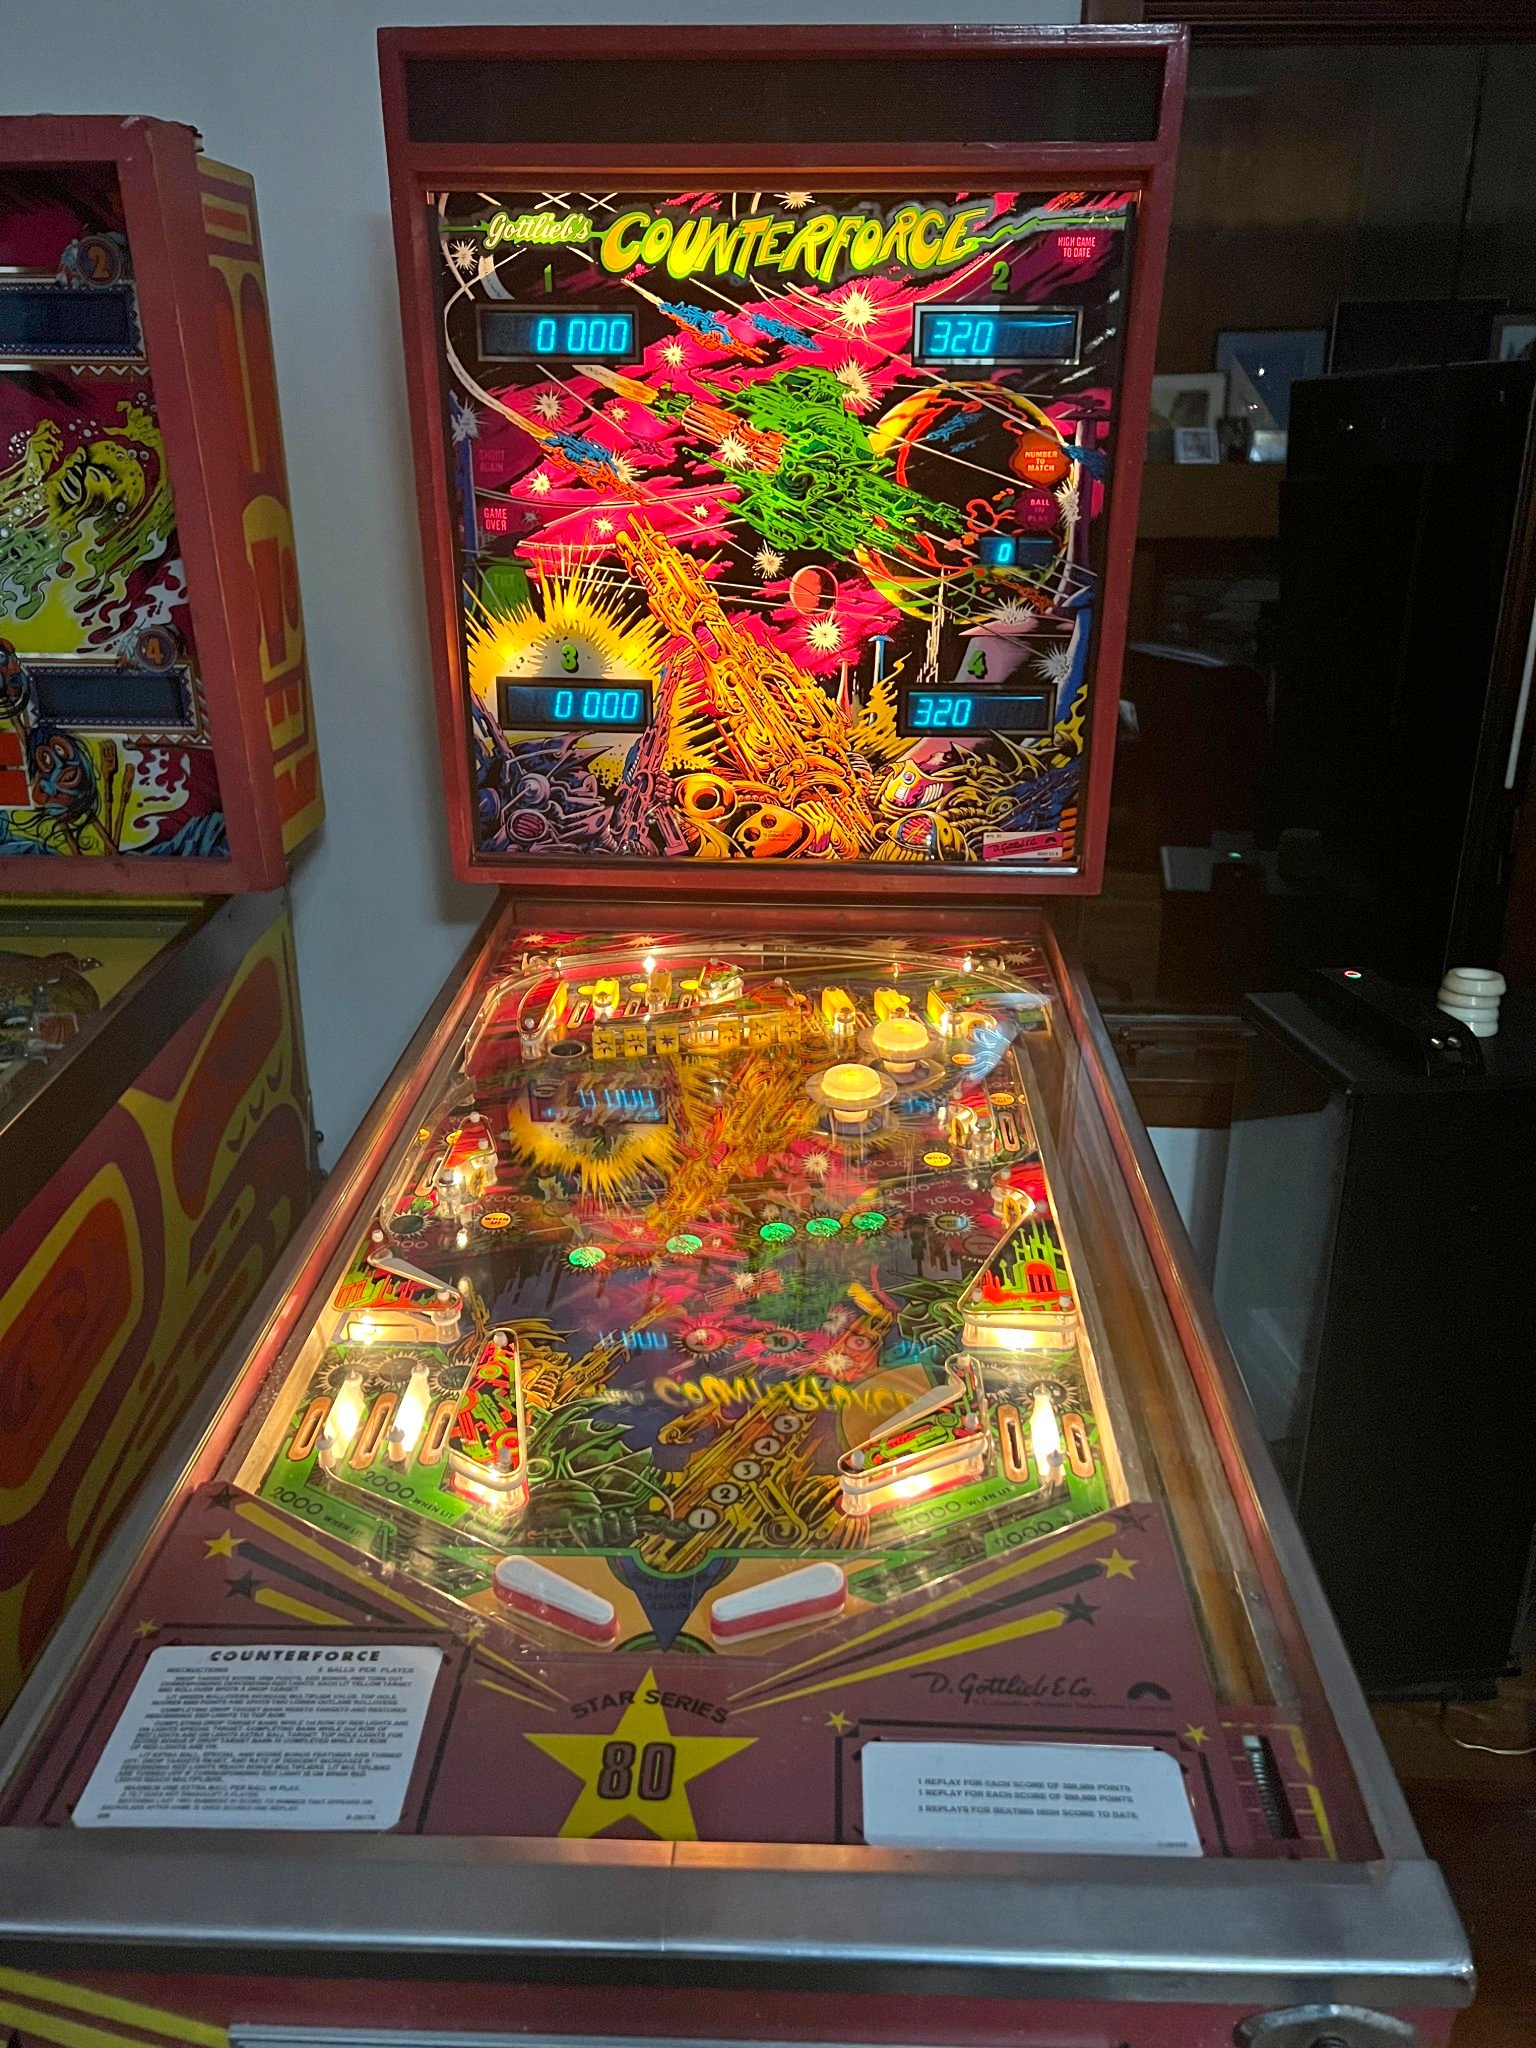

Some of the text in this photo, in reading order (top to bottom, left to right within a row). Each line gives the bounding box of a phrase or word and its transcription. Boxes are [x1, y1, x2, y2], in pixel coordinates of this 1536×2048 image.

[485, 207, 990, 283] Gottlieb's COUNTERFORCE
[1057, 236, 1096, 247] HIGH GAME
[1063, 248, 1091, 258] TO DATE
[544, 264, 552, 292] 1
[991, 261, 1010, 291] 2
[930, 321, 993, 353] 320
[483, 508, 507, 519] GAME
[485, 519, 507, 530] OVER
[998, 543, 1012, 562] 0
[493, 574, 516, 586] TILT
[147, 638, 163, 664] 4
[561, 644, 578, 671] 3
[967, 650, 986, 676] 4
[913, 699, 971, 726] 320
[784, 1421, 793, 1430] 5
[760, 1441, 771, 1451] 4
[742, 1465, 751, 1476] 3
[361, 1471, 455, 1520] 2000 WHEN LIT
[720, 1488, 731, 1499] 2
[270, 1487, 323, 1516] 2000
[323, 1515, 350, 1531] WHEN
[701, 1512, 705, 1525] 1
[903, 1500, 961, 1529] 2000
[210, 1650, 381, 1661] COUNTERFORCE
[957, 1673, 1050, 1705] Gottlieb
[571, 1689, 730, 1724] STAR SERIES
[597, 1740, 676, 1801] 80
[924, 1778, 961, 1786] REPLAY
[985, 1779, 1010, 1787] EACH
[1013, 1780, 1044, 1788] SCORE
[986, 1790, 1012, 1798] EACH
[925, 1804, 969, 1813] REPLAYS
[971, 1805, 990, 1813] FOR
[992, 1806, 1034, 1815] BEATING
[1037, 1808, 1060, 1816] HIGH
[1062, 1809, 1095, 1817] SCORE
[1097, 1810, 1110, 1818] TO
